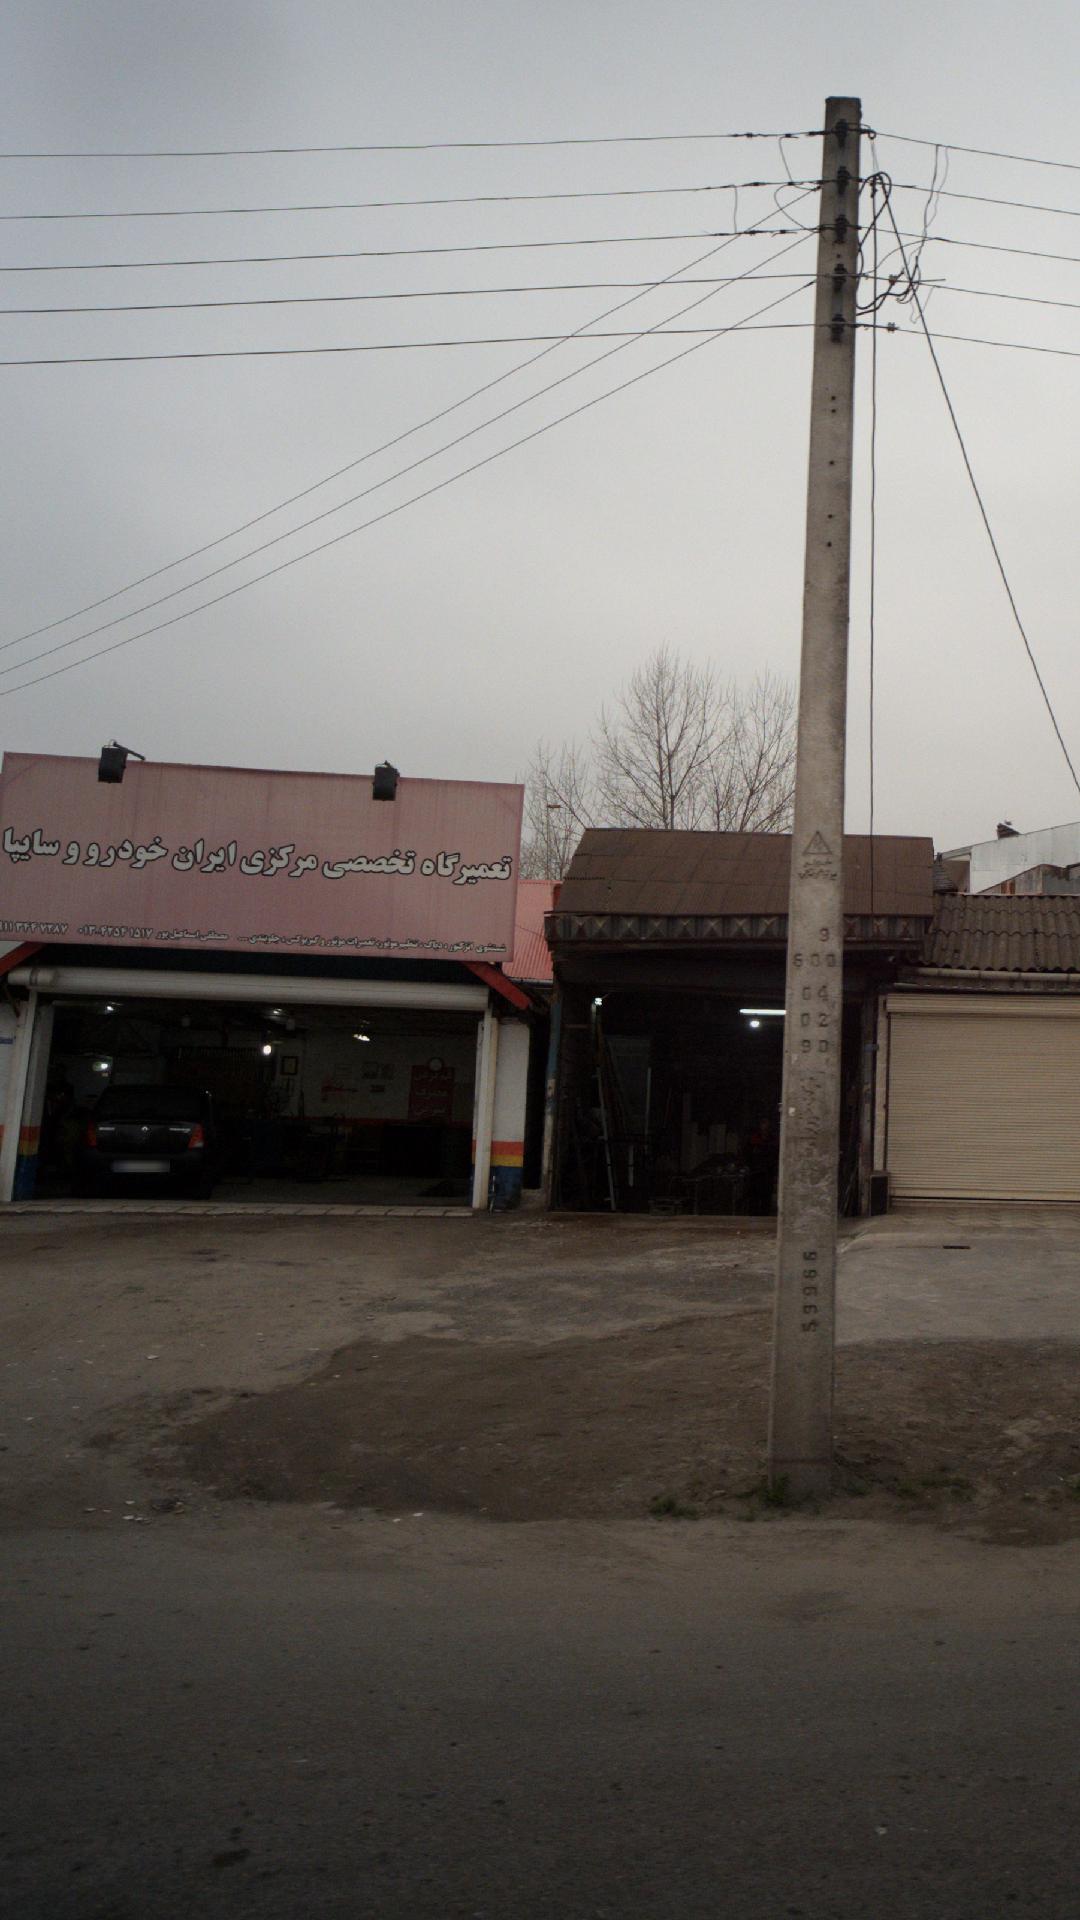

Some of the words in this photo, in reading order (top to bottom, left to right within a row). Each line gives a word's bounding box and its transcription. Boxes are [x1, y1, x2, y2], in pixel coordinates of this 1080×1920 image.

[2, 826, 60, 864] سایپا
[62, 840, 80, 865] و
[83, 836, 168, 869] خودرو
[171, 838, 238, 873] ایران
[240, 843, 318, 878] مرکزی
[322, 848, 416, 880] تخصصی
[420, 850, 513, 886] تعمیرگاه
[818, 927, 830, 943] 9
